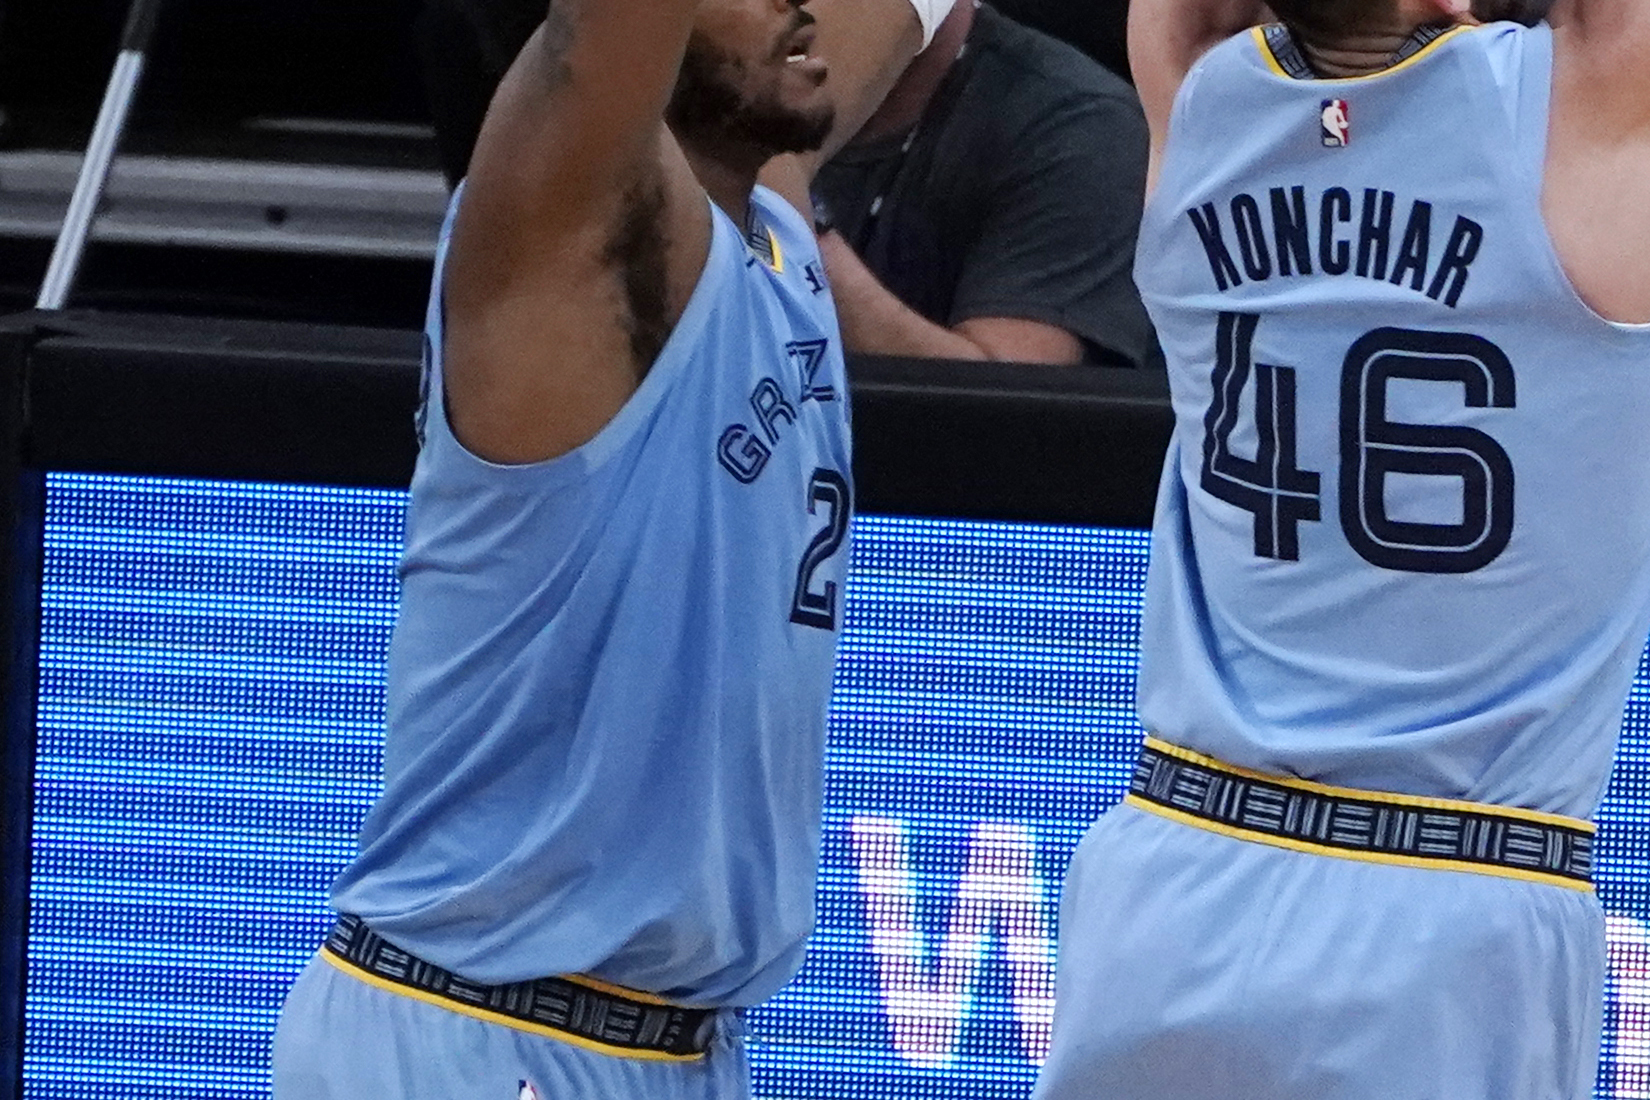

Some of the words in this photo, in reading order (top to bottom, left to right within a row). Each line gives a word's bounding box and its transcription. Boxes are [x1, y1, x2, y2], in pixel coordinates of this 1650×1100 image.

[1187, 185, 1483, 308] KONCHAR
[1200, 311, 1516, 574] 46
[789, 467, 852, 631] 2
